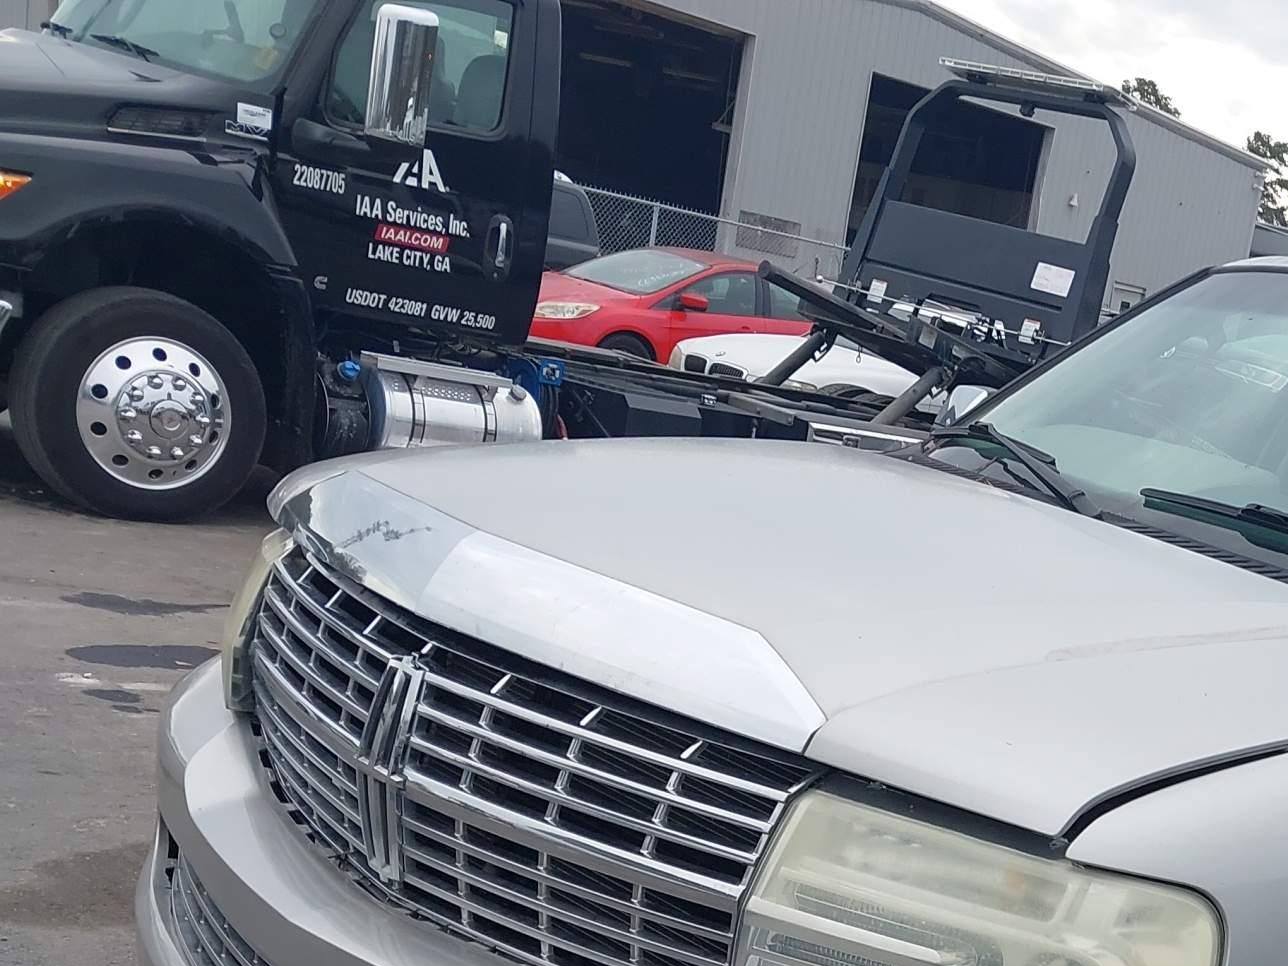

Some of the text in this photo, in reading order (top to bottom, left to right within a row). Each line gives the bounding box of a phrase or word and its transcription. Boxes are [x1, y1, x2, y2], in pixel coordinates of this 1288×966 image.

[293, 164, 346, 194] 22087705
[355, 194, 470, 237] IAA Services, Inc.
[381, 226, 444, 249] IAAI.COM
[368, 242, 451, 272] LAKE CITY, GA
[346, 288, 496, 329] USDOT 423081 GVW 25,500
